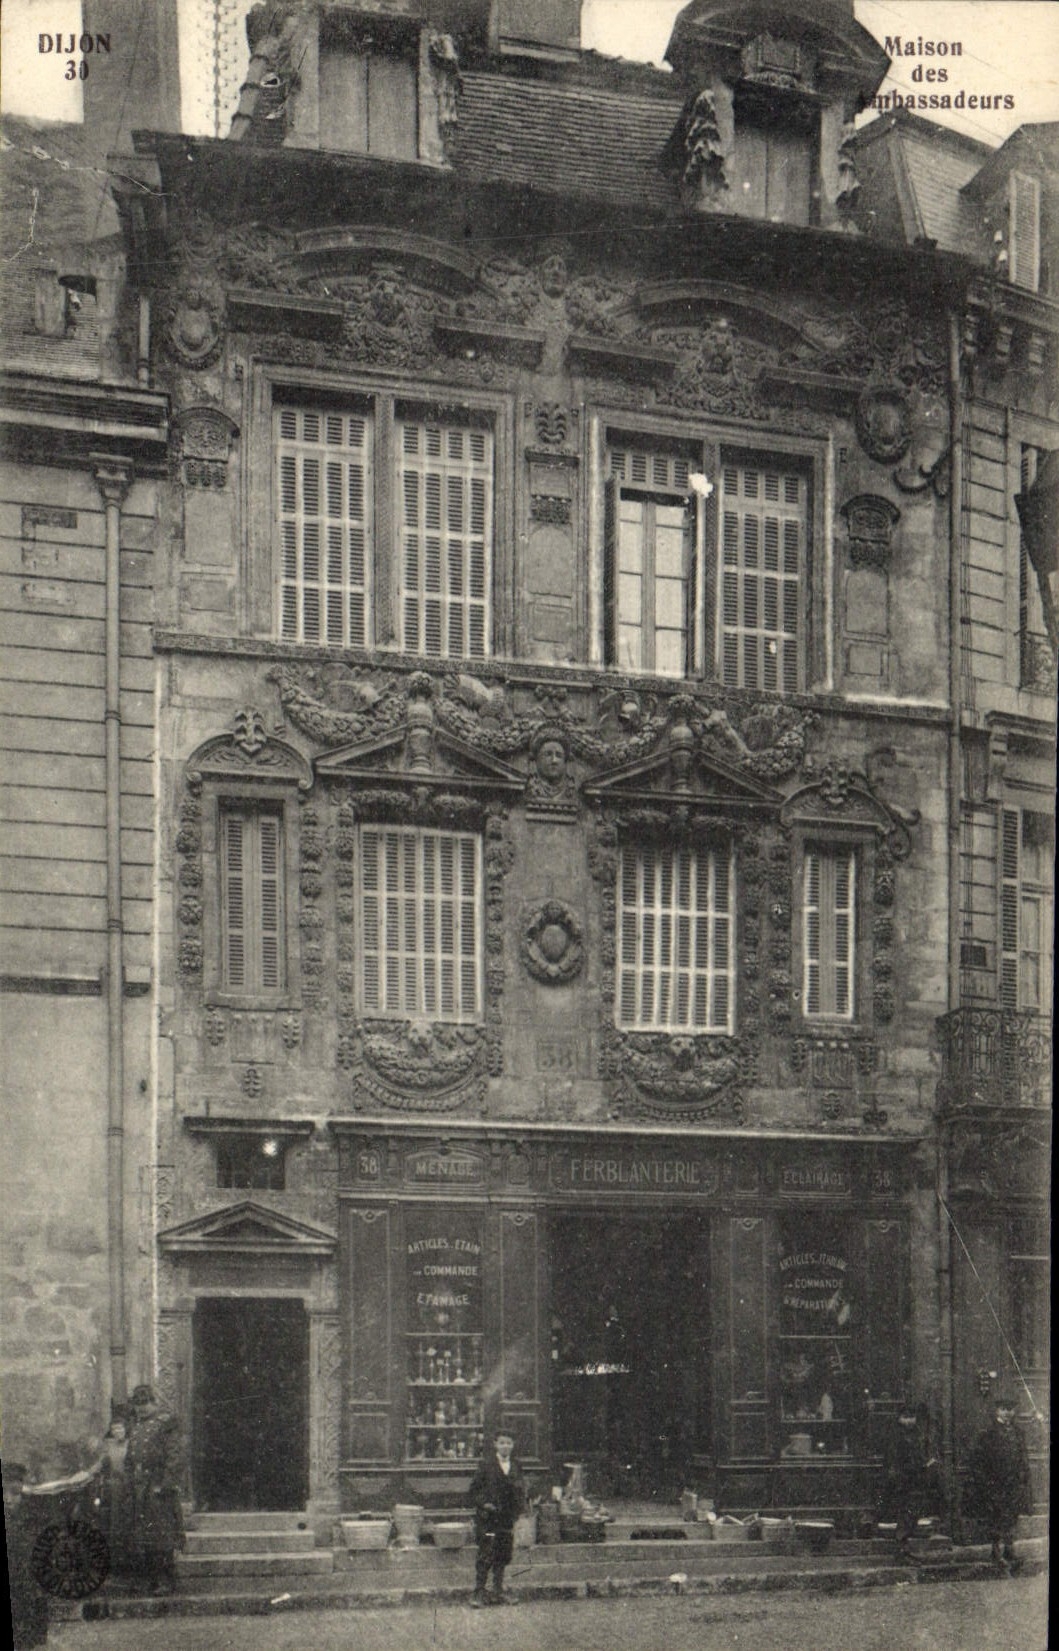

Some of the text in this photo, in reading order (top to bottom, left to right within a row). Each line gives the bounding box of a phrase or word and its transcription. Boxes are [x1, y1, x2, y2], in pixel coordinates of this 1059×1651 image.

[360, 1155, 378, 1175] 38
[570, 1159, 701, 1184] FERBLANTERIE
[423, 1265, 478, 1276] COMMANDE
